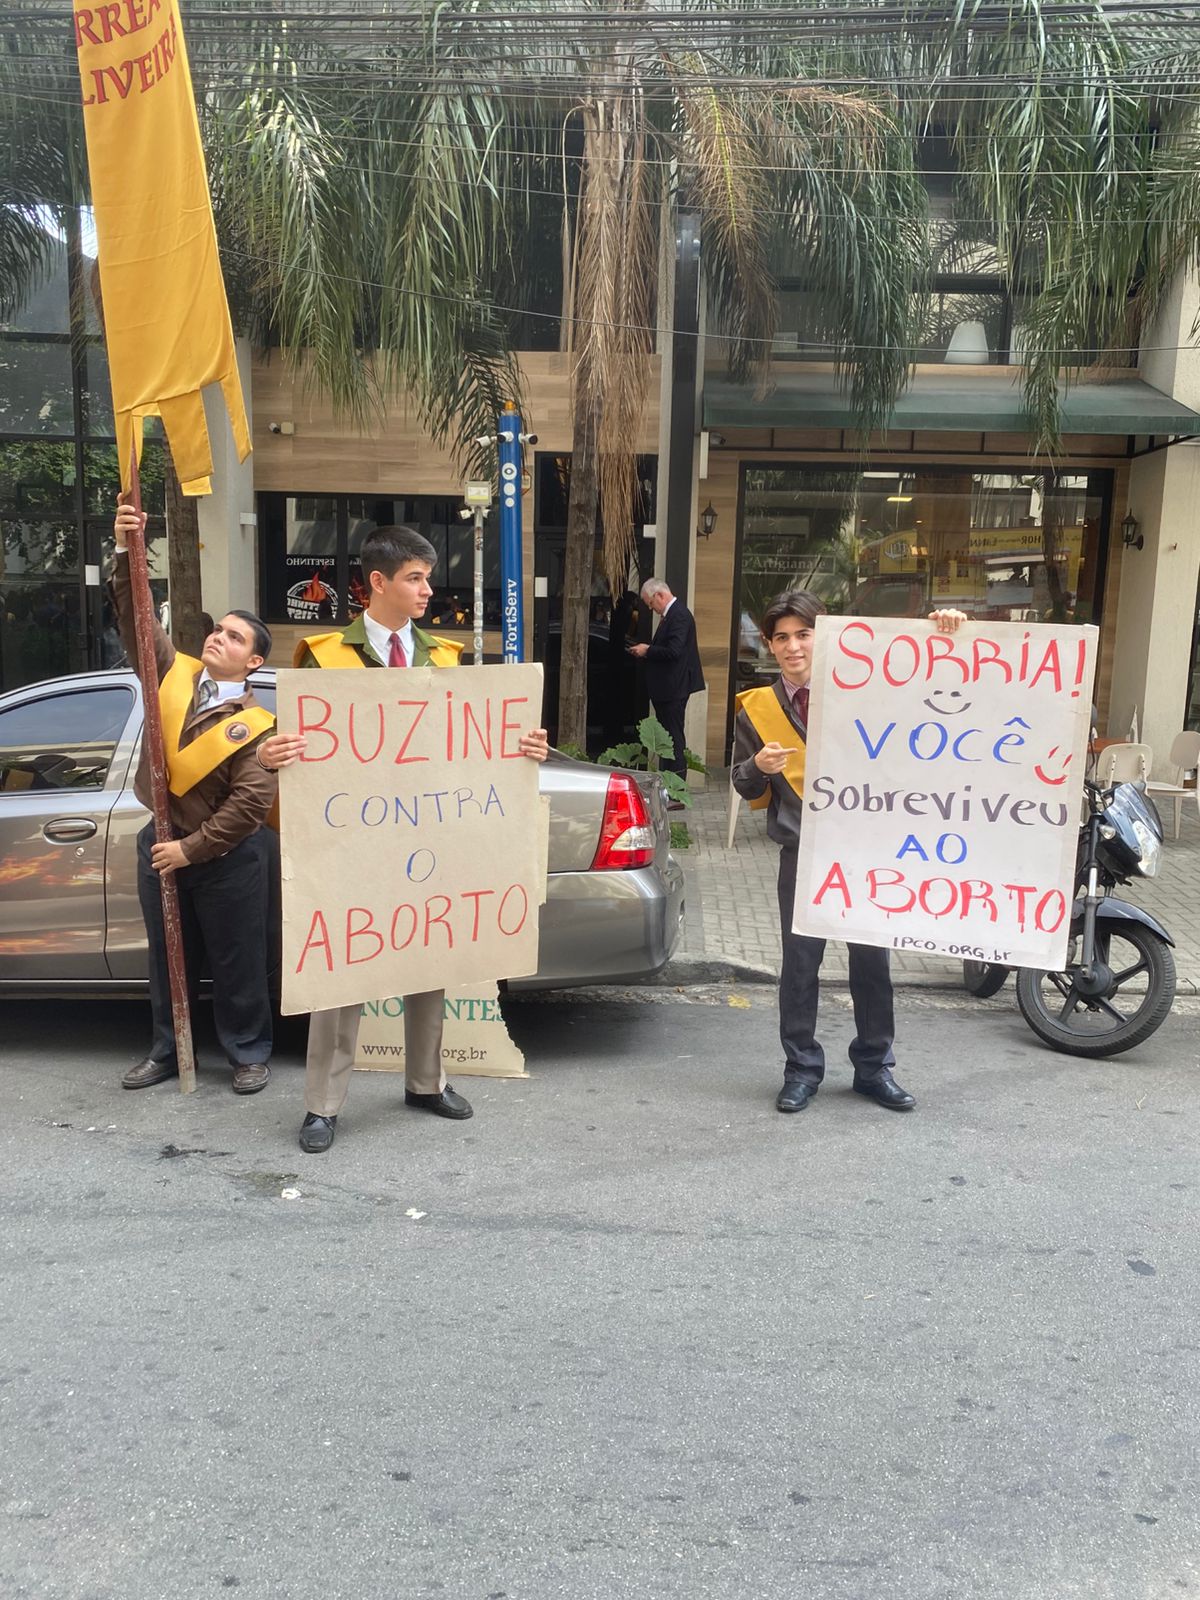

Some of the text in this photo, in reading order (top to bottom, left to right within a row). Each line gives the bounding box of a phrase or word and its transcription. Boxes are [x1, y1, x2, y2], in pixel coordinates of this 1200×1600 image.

[505, 578, 518, 652] FortServ
[325, 784, 505, 827] CONTRA
[808, 776, 1068, 827] Sobreviveu
[406, 848, 436, 882] O
[895, 833, 968, 864] AO
[812, 862, 1066, 933] ABORTO
[296, 884, 528, 973] ABORTO
